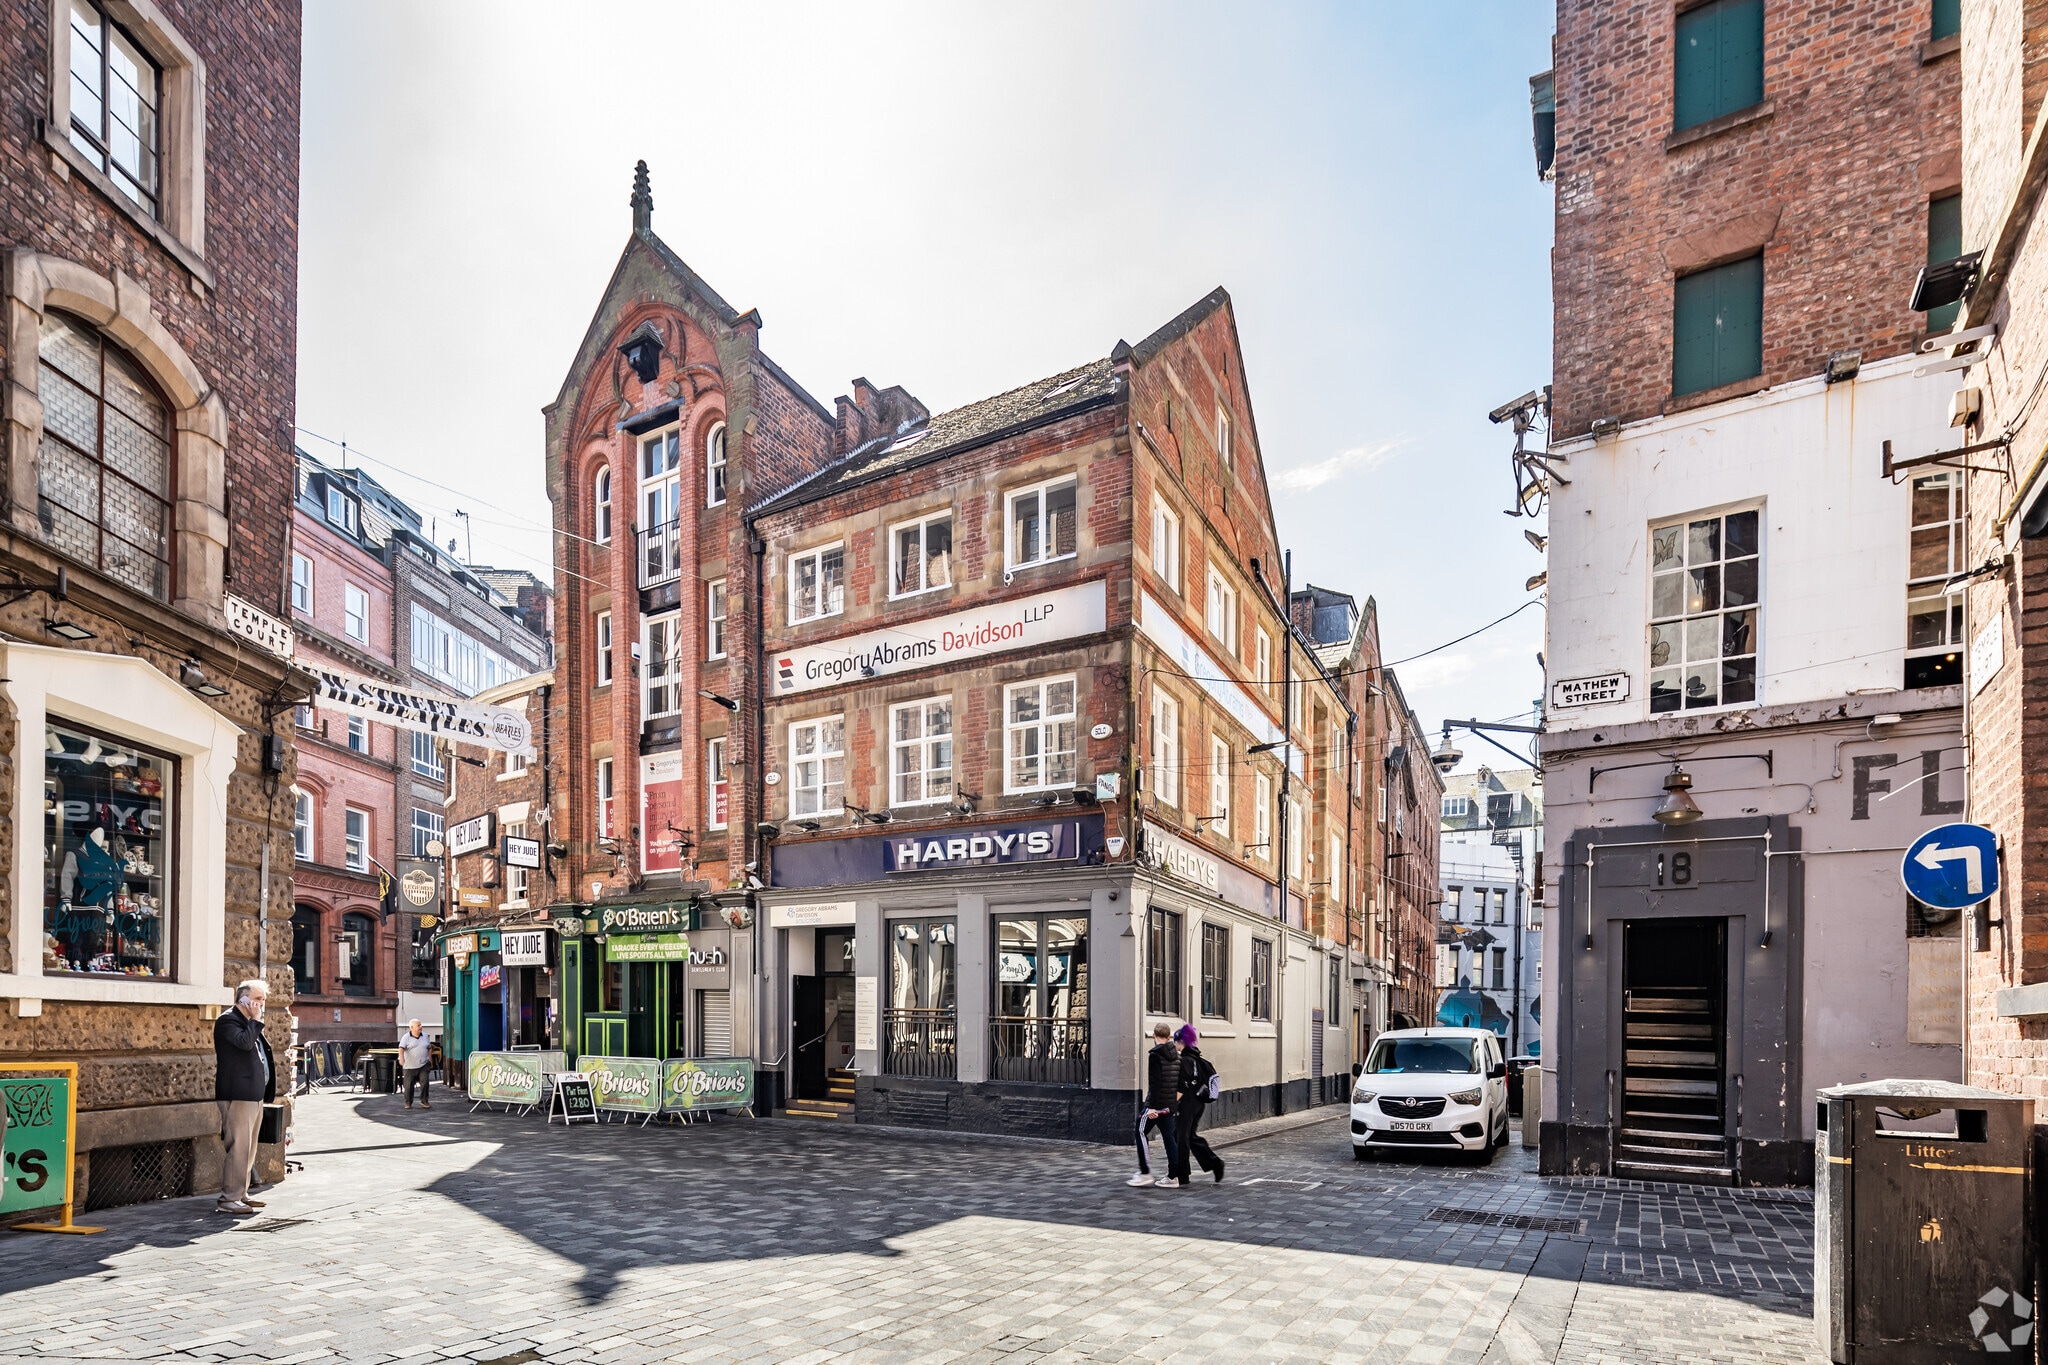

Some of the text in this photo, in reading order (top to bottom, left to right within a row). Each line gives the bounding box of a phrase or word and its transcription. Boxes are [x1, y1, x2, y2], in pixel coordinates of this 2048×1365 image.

[231, 602, 287, 640] TEMPLE
[943, 620, 1023, 652] Davidson
[1024, 604, 1055, 624] LLP
[234, 619, 286, 651] COURT
[1563, 677, 1619, 693] MATHEW
[358, 683, 458, 716] STREET
[1565, 690, 1617, 703] STREET
[377, 700, 486, 737] BEATLES
[495, 722, 522, 738] BEATLES
[649, 791, 666, 800] From
[456, 819, 482, 847] HEY JUDE
[509, 844, 537, 857] HEY JUDE
[899, 831, 1050, 864] HARDY'S
[1657, 852, 1692, 886] 18
[404, 884, 433, 892] LEGENDS
[463, 893, 489, 901] LEGENDS
[447, 935, 473, 954] LEGENDS
[505, 935, 541, 955] HEY JUDE
[611, 942, 688, 952] KARAOKE EVERY WEEKEND
[616, 951, 629, 959] LIVE
[629, 951, 654, 959] SPORTS
[665, 950, 683, 958] WEEK
[688, 946, 723, 964] hush
[477, 1064, 534, 1090] O'Brien's
[673, 1069, 746, 1096] O'Brien's
[1395, 1122, 1431, 1131] DS70 GRX
[1906, 1144, 1954, 1158] Litter
